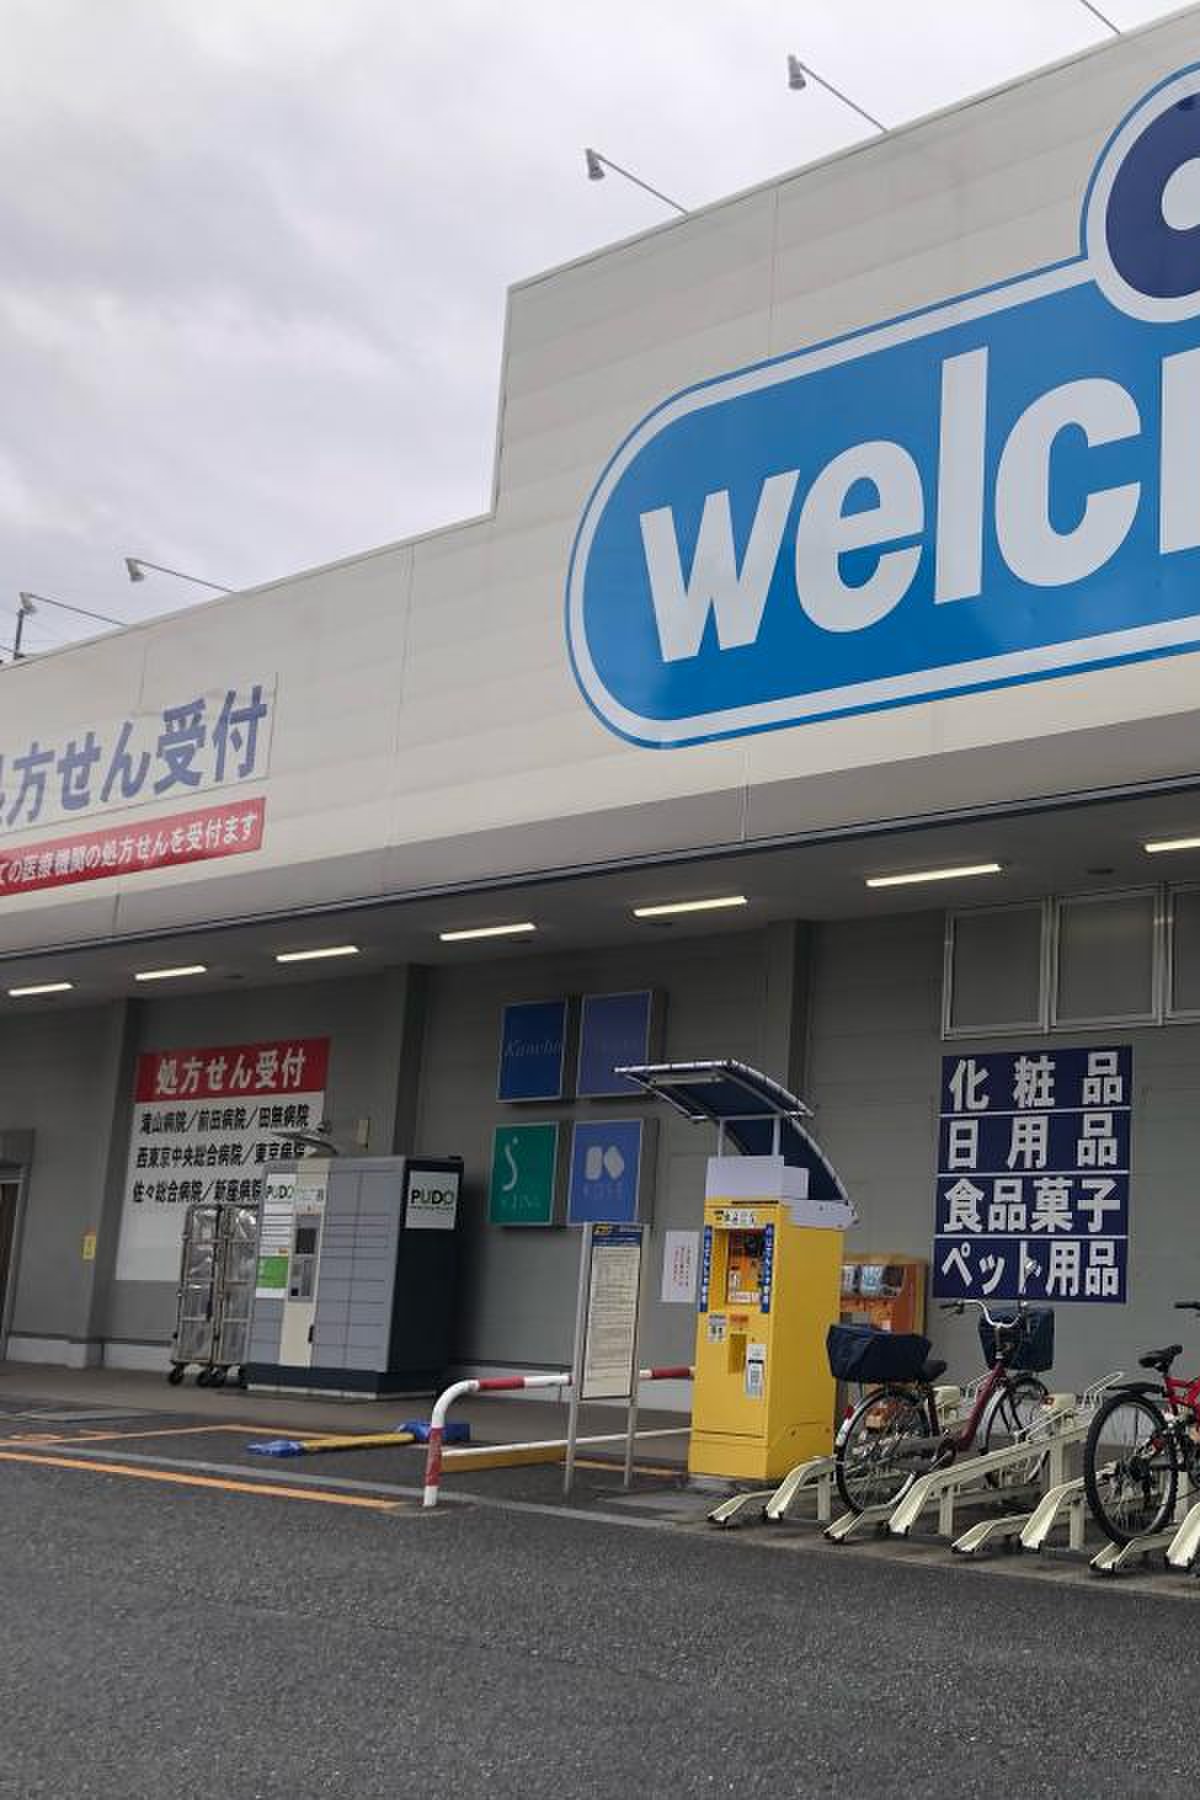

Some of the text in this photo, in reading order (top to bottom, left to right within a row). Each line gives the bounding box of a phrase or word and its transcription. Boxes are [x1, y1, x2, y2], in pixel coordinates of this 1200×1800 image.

[0, 685, 267, 827] 方せん受付
[156, 1048, 305, 1095] 処方せん受付
[949, 1052, 1122, 1112] 化粧品
[948, 1113, 1117, 1168] 日用品
[944, 1178, 1120, 1233] 食品菓子
[942, 1241, 1119, 1296] ペット用品
